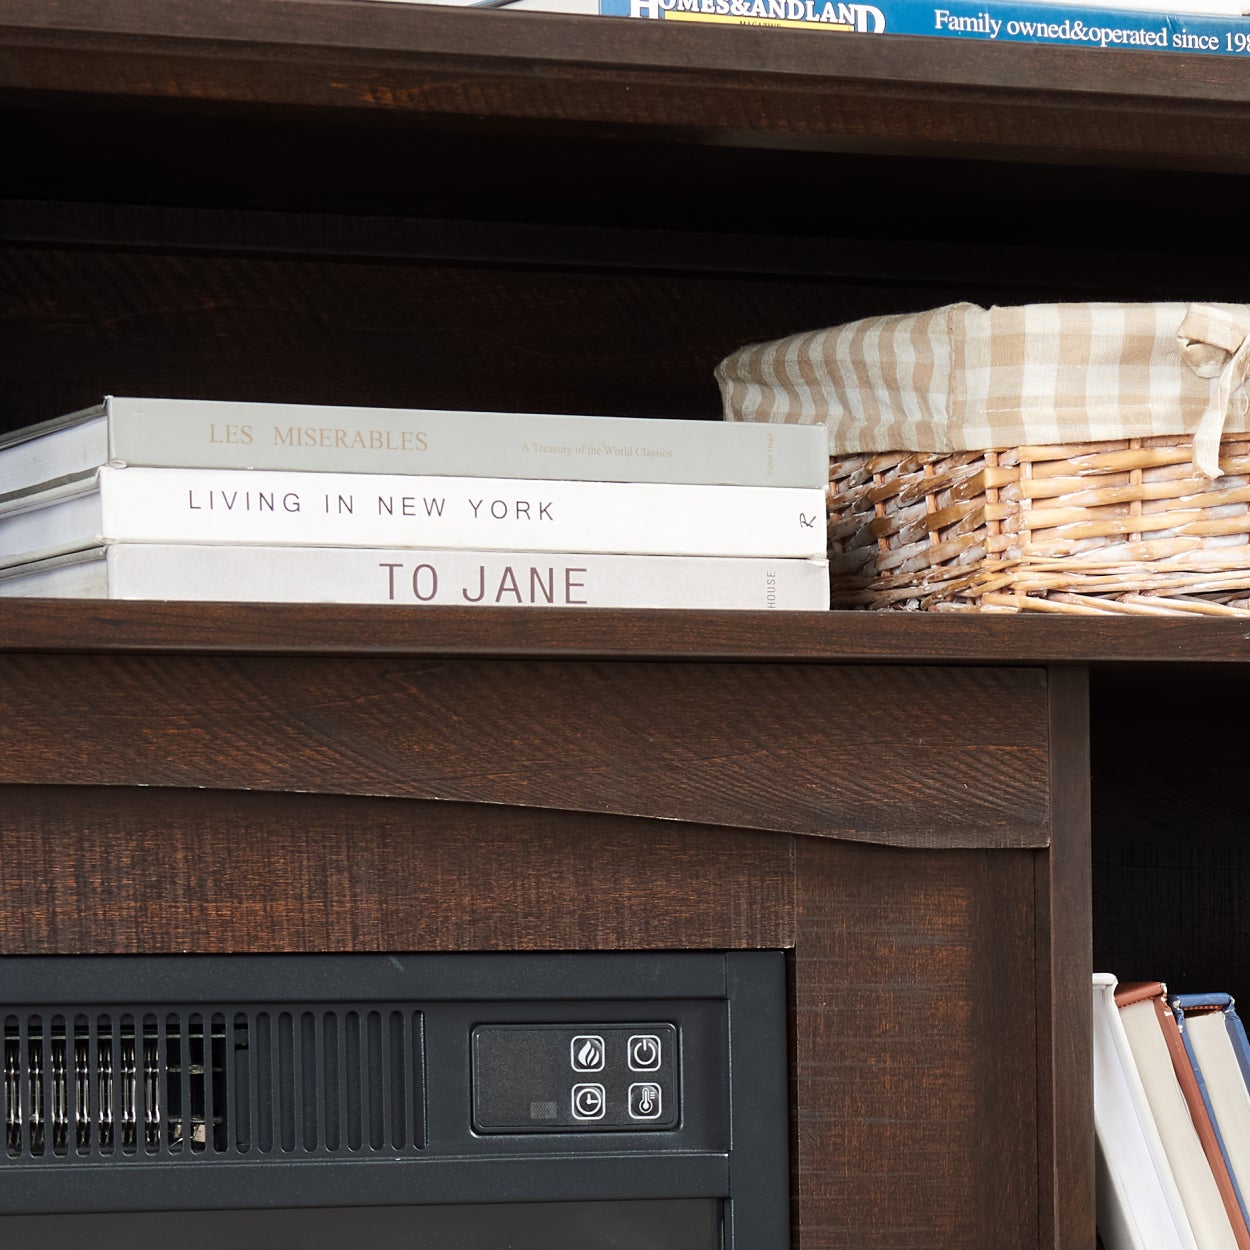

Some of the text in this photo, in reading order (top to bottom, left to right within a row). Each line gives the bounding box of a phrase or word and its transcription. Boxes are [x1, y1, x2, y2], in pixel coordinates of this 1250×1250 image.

[934, 9, 1002, 39] Family
[1007, 20, 1168, 47] owned&operated
[1172, 30, 1219, 50] since
[209, 423, 428, 451] LES MISERABLES
[189, 490, 554, 521] LIVING IN NEW YORK
[379, 563, 587, 605] TO JANE
[766, 570, 777, 609] HOUSE
